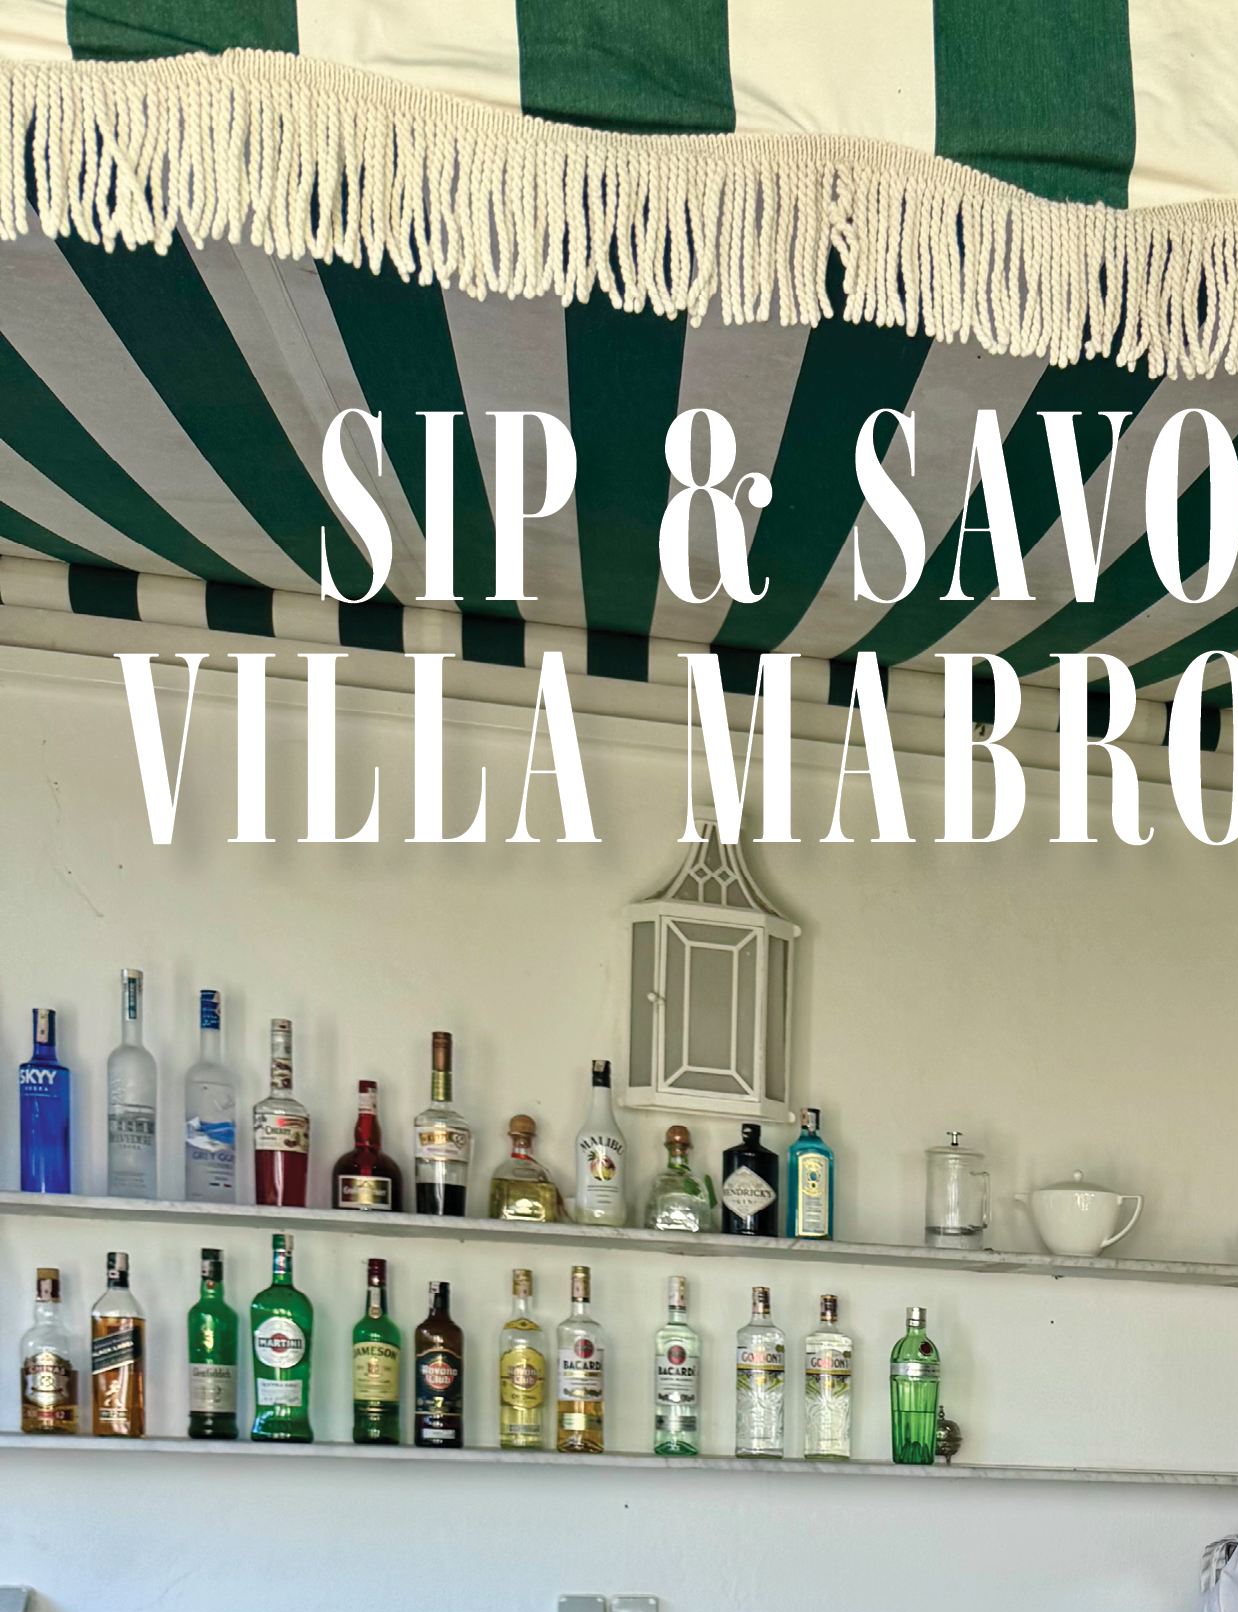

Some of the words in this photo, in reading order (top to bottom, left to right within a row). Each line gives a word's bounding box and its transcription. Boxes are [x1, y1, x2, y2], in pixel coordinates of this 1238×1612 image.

[20, 1069, 57, 1085] SKYY
[580, 1136, 624, 1156] MALIBU
[259, 1338, 302, 1349] MARTINI
[355, 1346, 398, 1360] JAMESON
[422, 1364, 458, 1376] Havana
[429, 1374, 451, 1384] Club
[433, 1396, 444, 1408] 7
